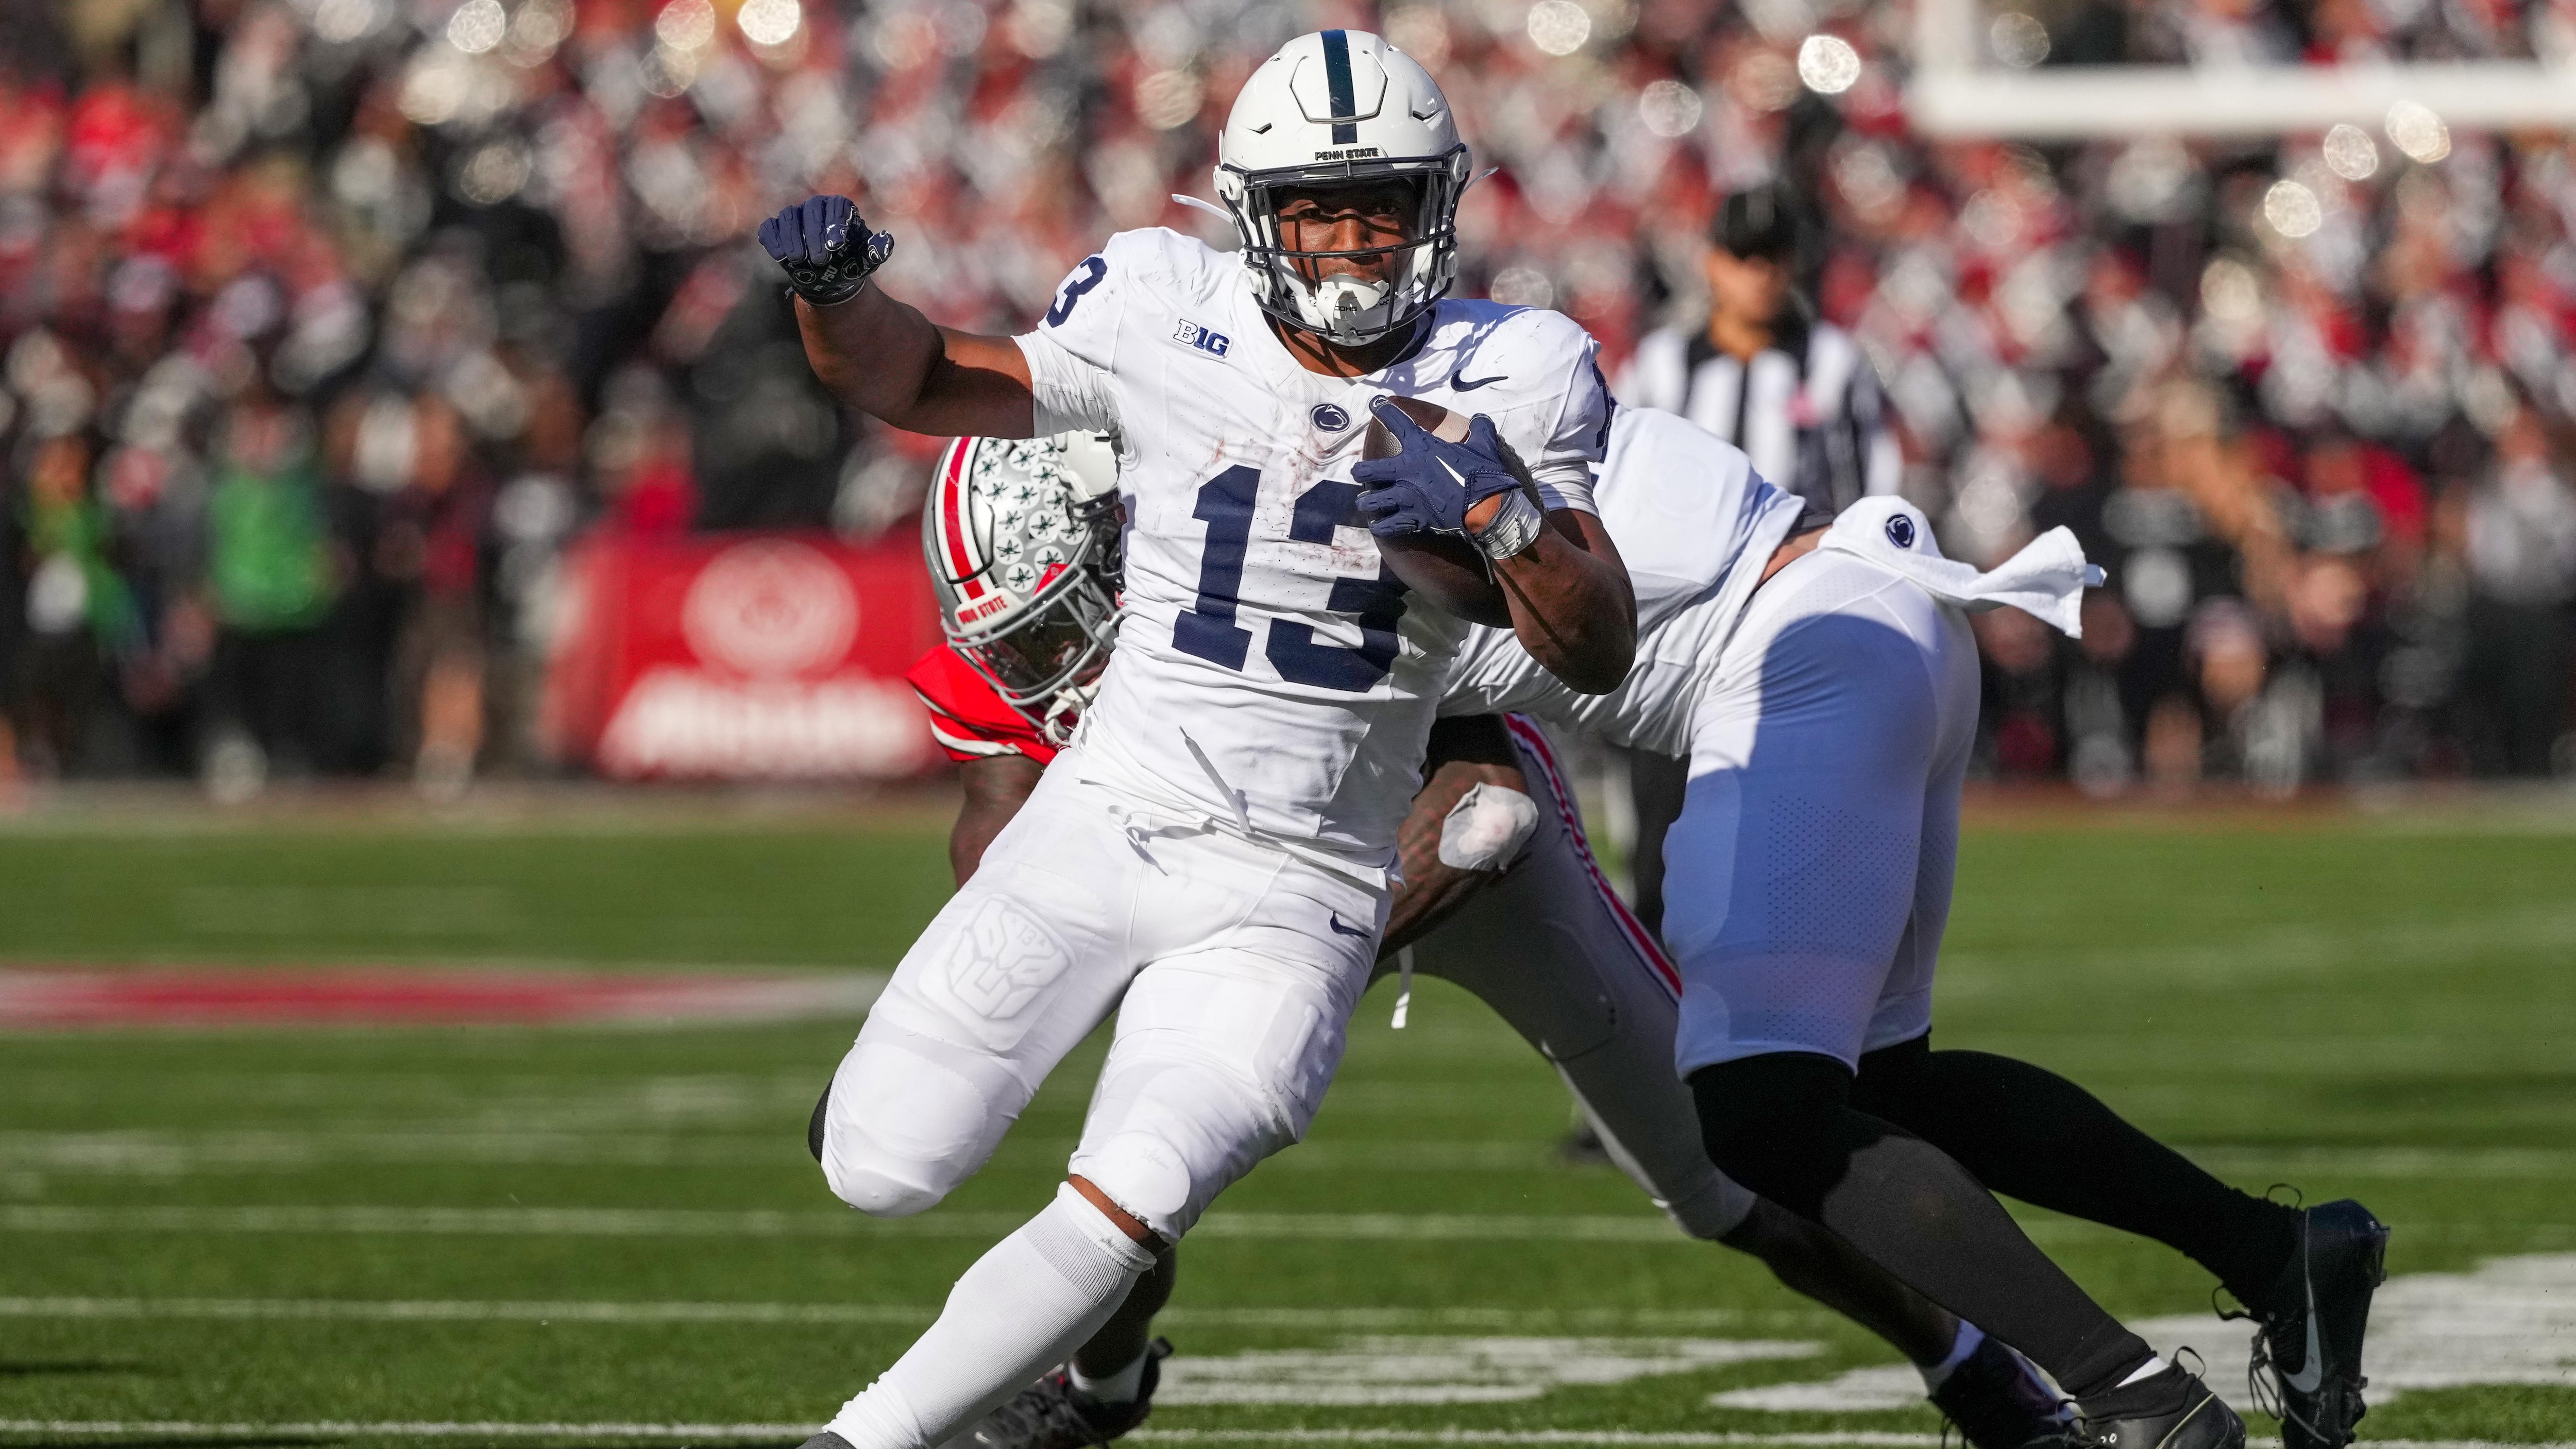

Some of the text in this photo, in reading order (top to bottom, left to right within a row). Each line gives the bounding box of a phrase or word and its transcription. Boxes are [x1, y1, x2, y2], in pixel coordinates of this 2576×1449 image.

[1315, 147, 1379, 161] PENN STATE
[821, 264, 838, 282] PSU
[1172, 464, 1408, 693] 13
